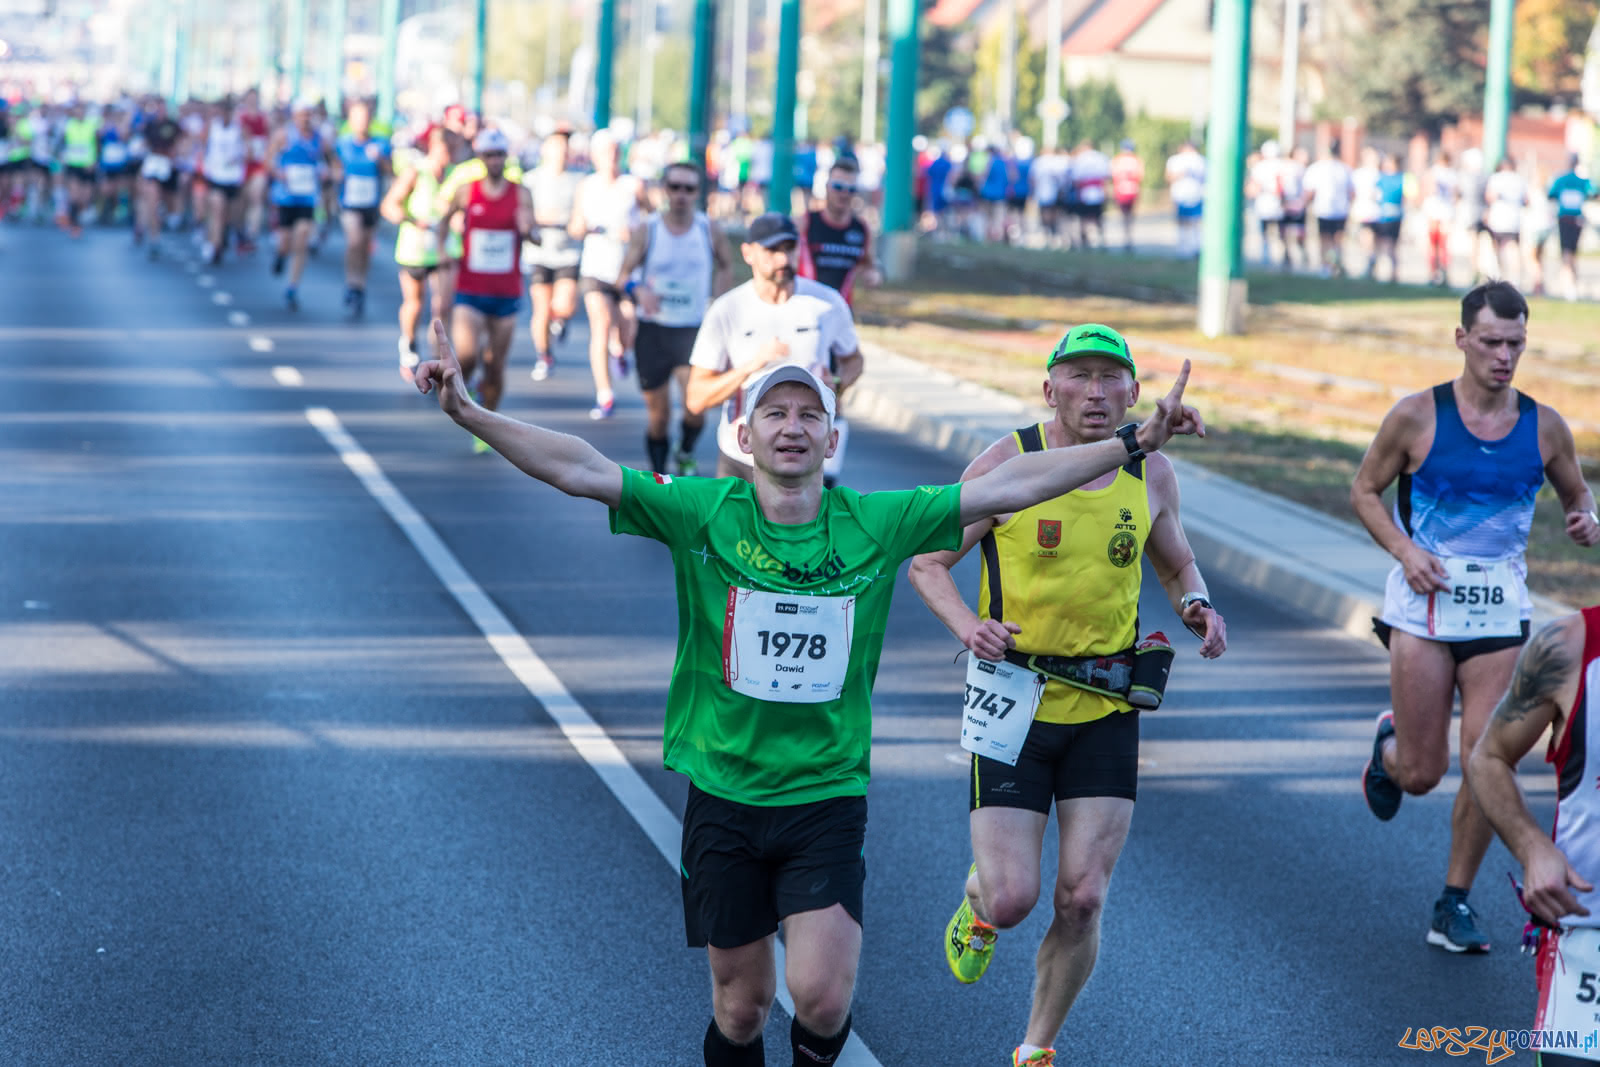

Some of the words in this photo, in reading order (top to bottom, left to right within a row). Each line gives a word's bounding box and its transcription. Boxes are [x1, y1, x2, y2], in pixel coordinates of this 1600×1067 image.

[1453, 585, 1504, 605] 5518
[757, 630, 827, 660] 1978
[775, 663, 805, 673] Dawid
